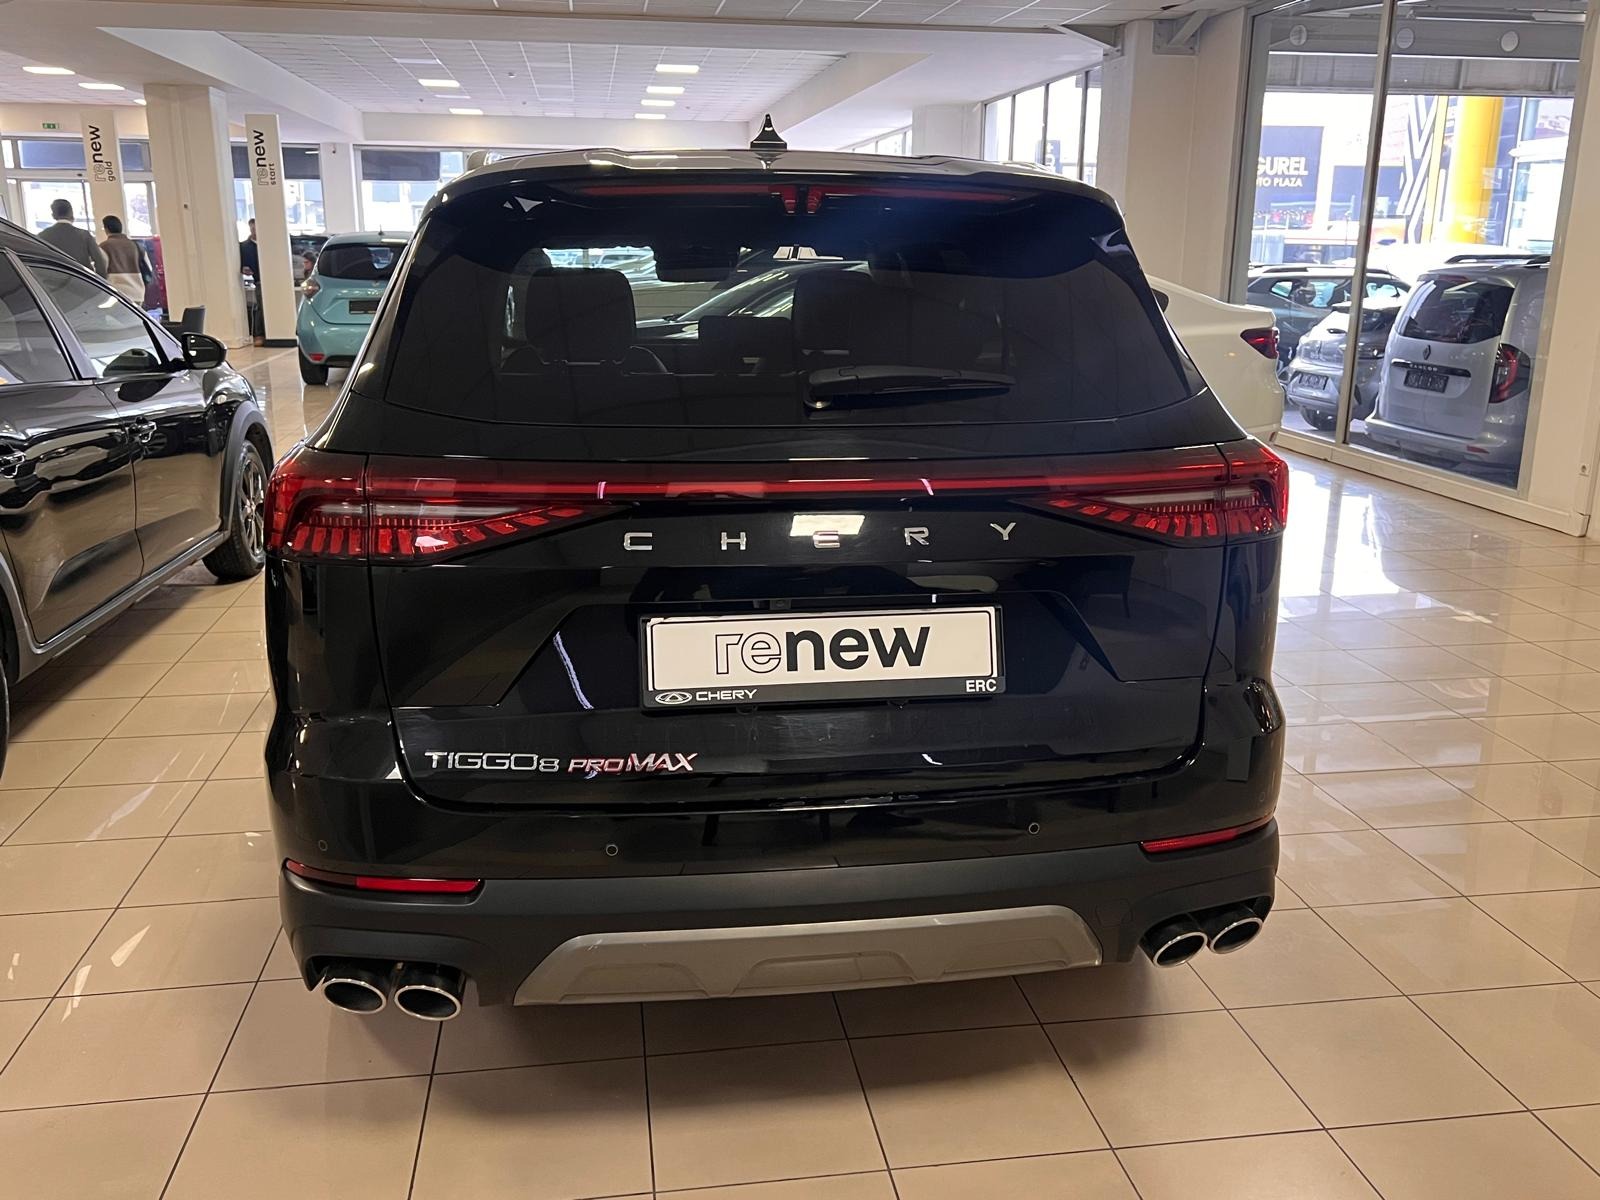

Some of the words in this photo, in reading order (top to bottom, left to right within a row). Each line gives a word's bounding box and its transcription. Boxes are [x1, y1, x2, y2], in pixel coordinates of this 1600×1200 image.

[88, 125, 106, 183] renew
[252, 130, 269, 186] renew
[105, 161, 116, 181] gold
[269, 163, 277, 186] start
[1274, 178, 1302, 187] PLAZA
[622, 521, 1018, 552] CHERY
[714, 626, 930, 675] renew
[695, 688, 757, 702] CHERY
[965, 679, 998, 693] ERC
